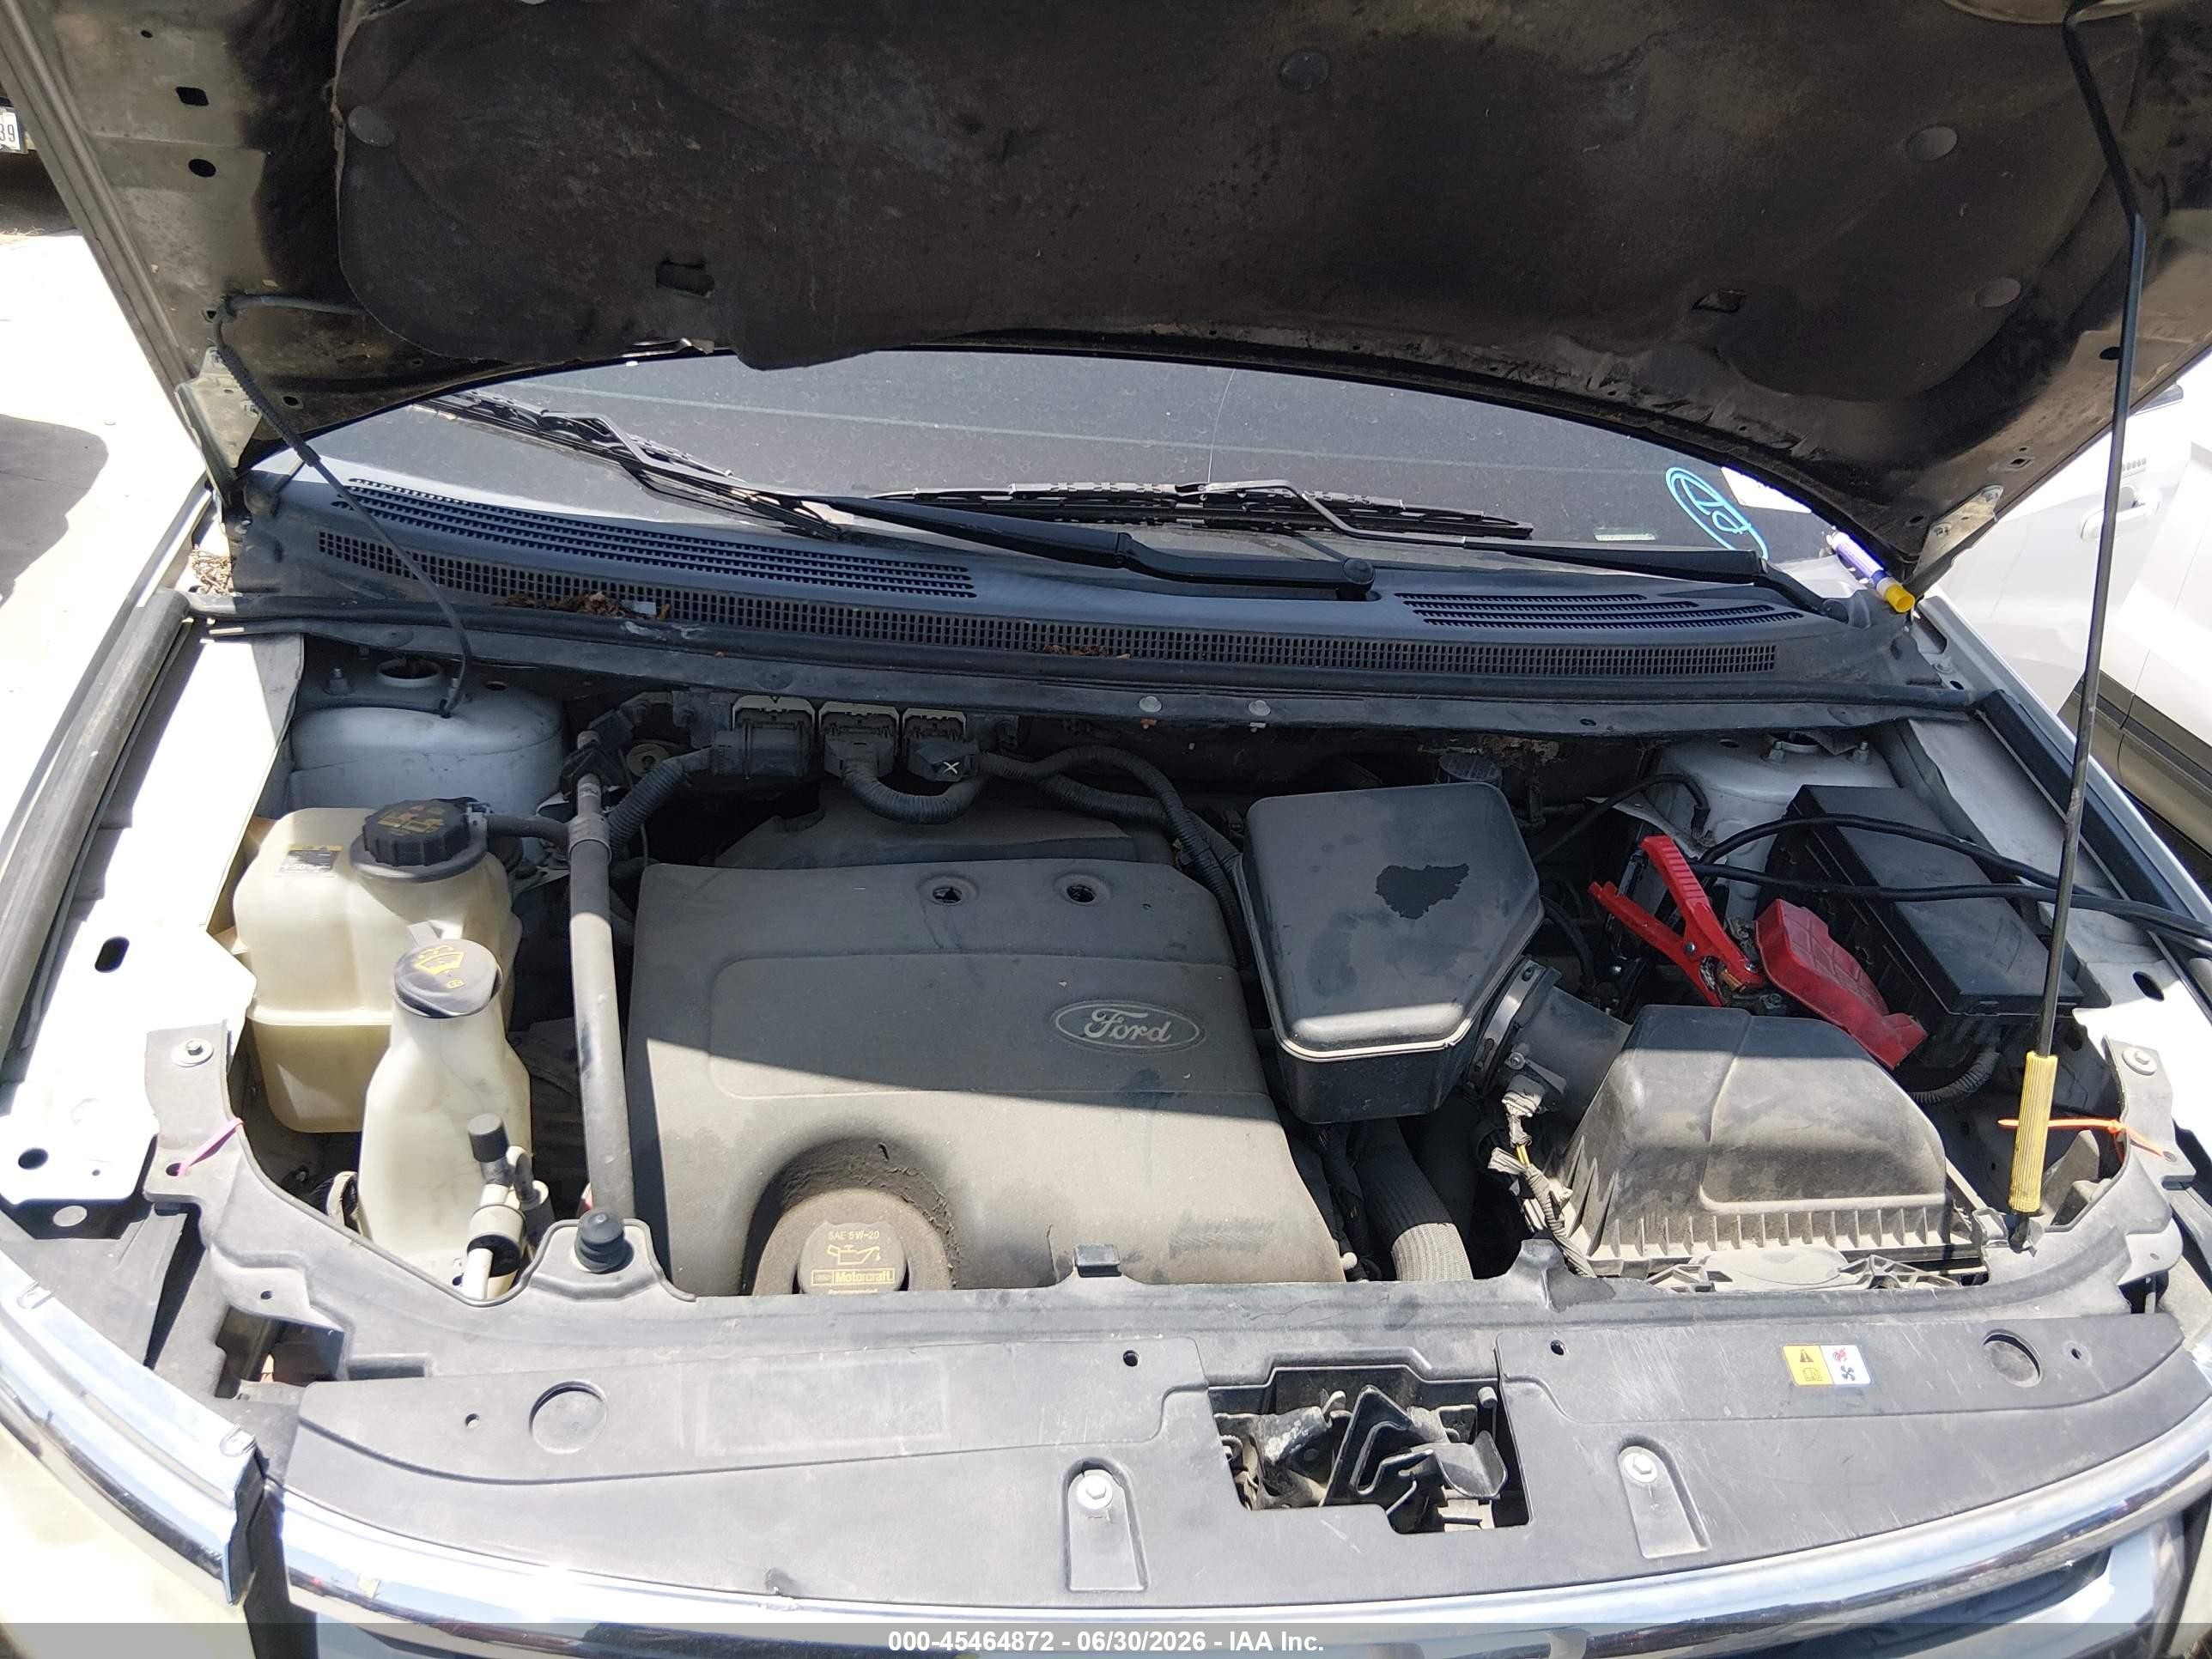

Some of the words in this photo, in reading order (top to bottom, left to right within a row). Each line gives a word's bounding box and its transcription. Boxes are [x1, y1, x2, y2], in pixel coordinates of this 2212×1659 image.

[1084, 1008, 1172, 1042] Ford
[828, 1231, 847, 1240] SAE
[849, 1230, 880, 1240] 5W-20
[835, 1271, 891, 1283] Motorcraft
